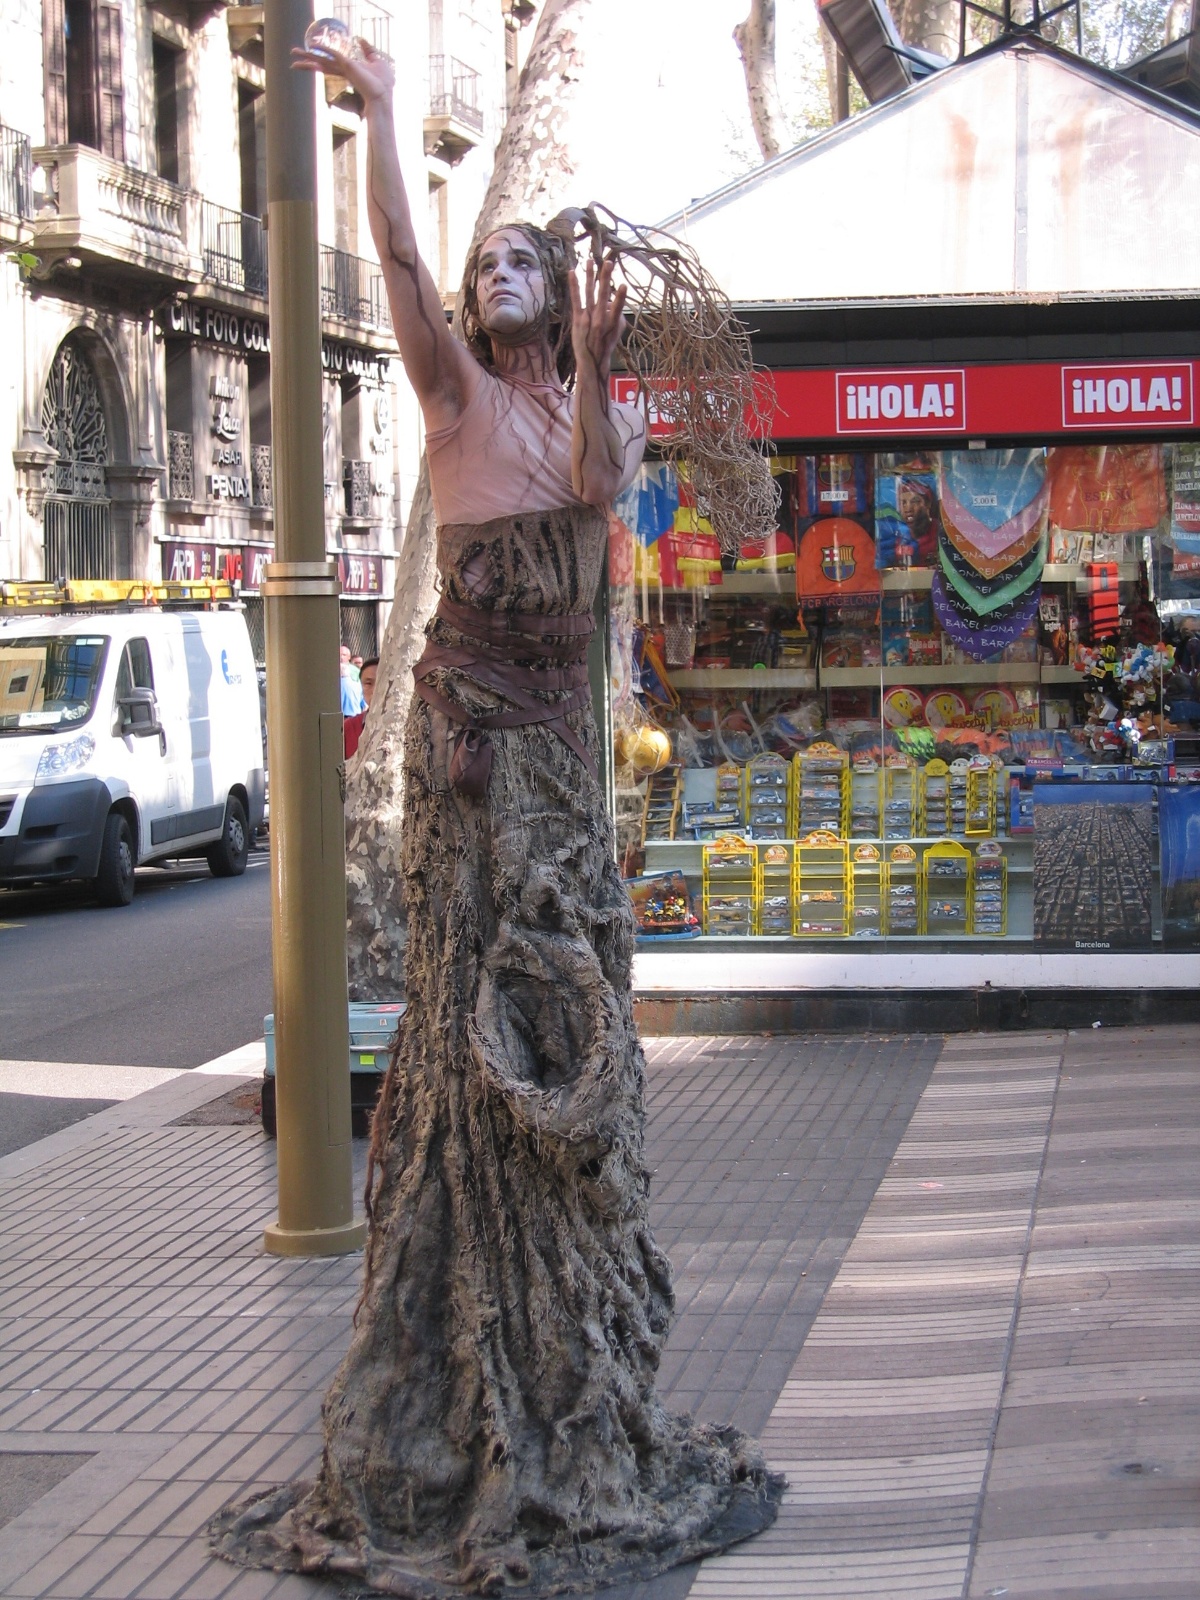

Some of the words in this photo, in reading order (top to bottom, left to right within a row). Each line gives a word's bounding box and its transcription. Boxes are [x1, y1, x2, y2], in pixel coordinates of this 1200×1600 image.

[170, 302, 201, 336] CINE
[206, 309, 239, 345] FOTO
[243, 320, 270, 353] COL
[321, 342, 343, 371] OTO
[346, 347, 379, 379] COLOR
[215, 376, 240, 400] Nikon
[846, 383, 955, 420] ¡HOLA!
[1072, 377, 1182, 414] ¡HOLA!
[217, 401, 241, 440] Leica
[212, 475, 250, 498] PENTAX
[169, 549, 195, 581] ARPI
[346, 559, 364, 589] ARPI
[1075, 940, 1110, 948] Barcelona
